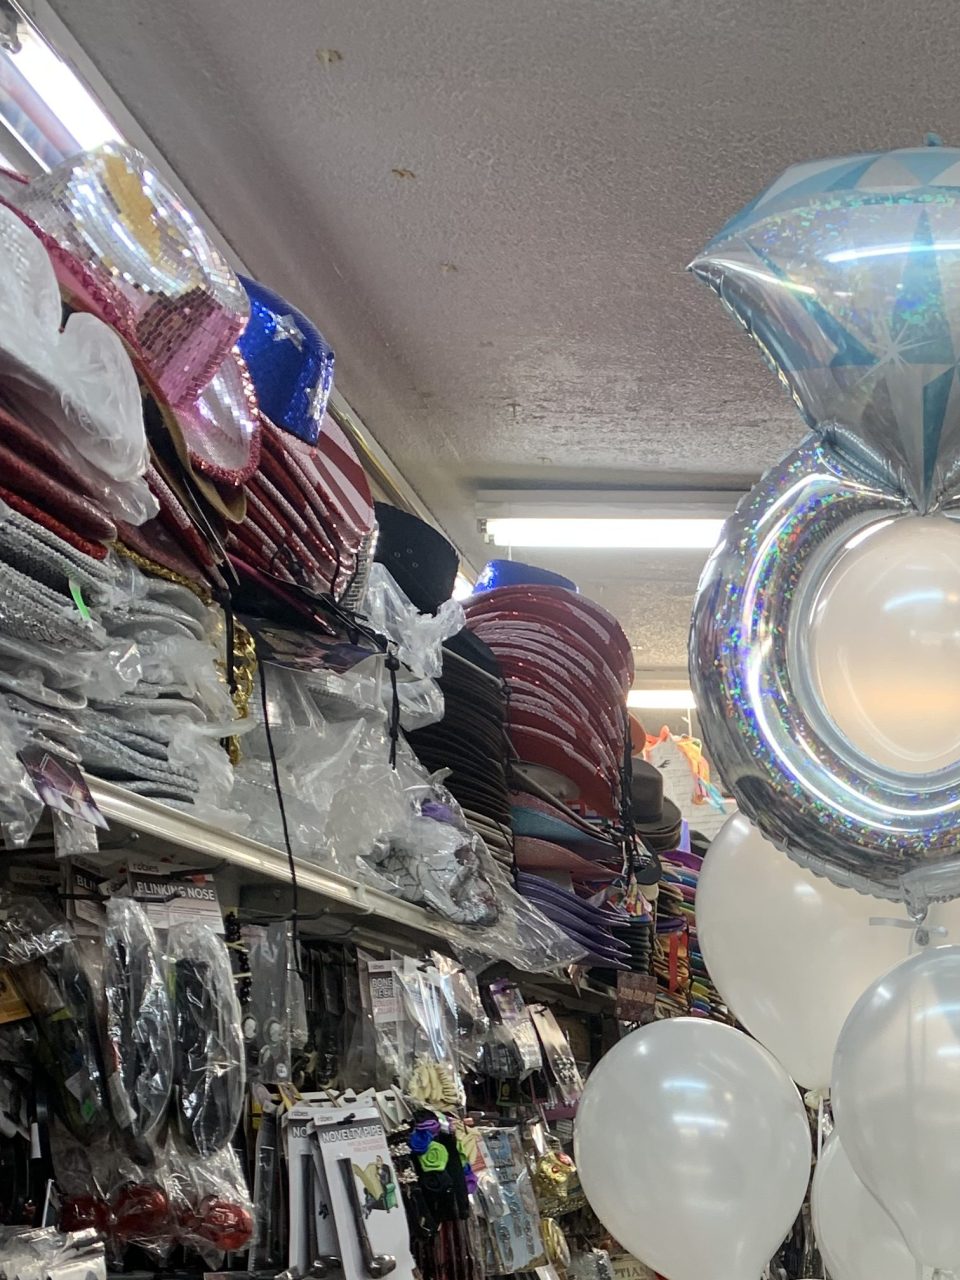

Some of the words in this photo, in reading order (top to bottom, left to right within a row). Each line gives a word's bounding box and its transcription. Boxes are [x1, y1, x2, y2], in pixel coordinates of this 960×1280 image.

[137, 881, 186, 898] BLINKING
[187, 887, 215, 900] NOSE
[372, 977, 393, 987] BONE
[322, 1126, 363, 1143] NOVELTY
[363, 1124, 383, 1138] PIPE
